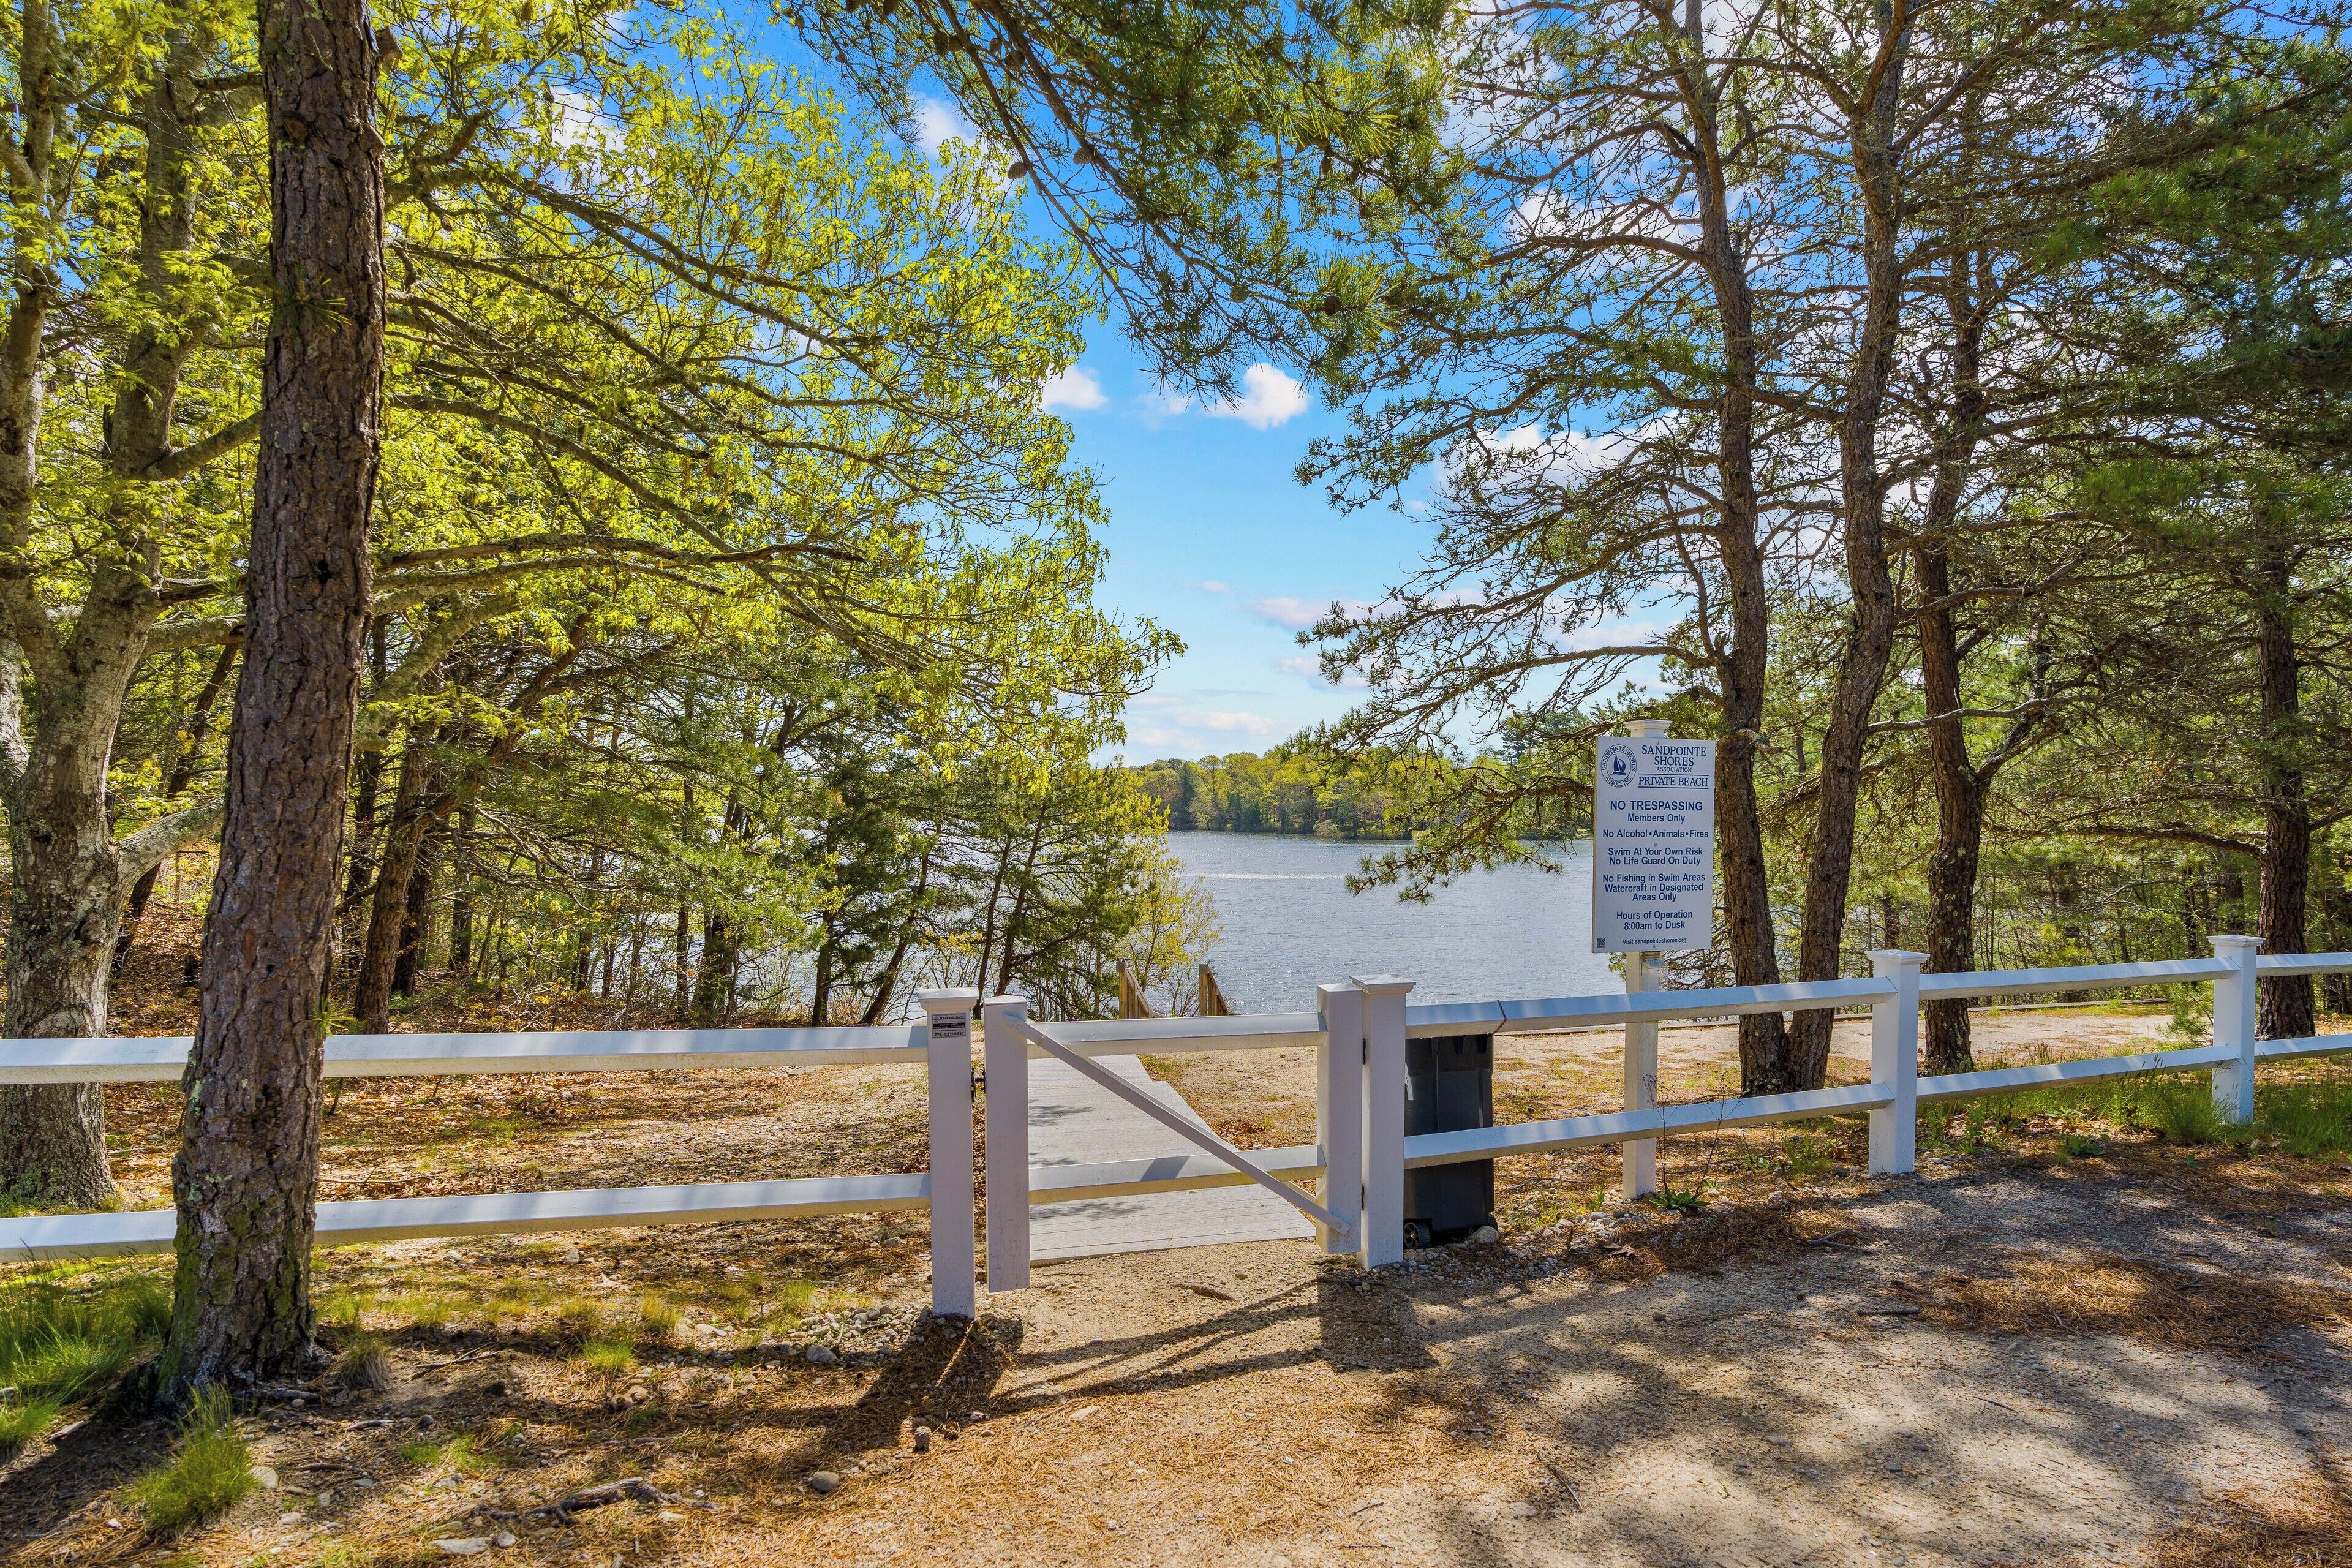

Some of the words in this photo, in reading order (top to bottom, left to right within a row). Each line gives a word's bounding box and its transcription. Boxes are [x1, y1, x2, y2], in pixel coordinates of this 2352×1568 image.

[1642, 745, 1706, 756] SANDPOINTE
[1602, 746, 1625, 770] SANDPOINTE
[1626, 749, 1635, 771] SHORES
[1654, 756, 1694, 766] SHORES
[1638, 776, 1676, 785] PRIVATE
[1678, 777, 1708, 786] BEACH
[1610, 800, 1626, 810] NO
[1630, 801, 1703, 811] TRESPASSING
[1627, 813, 1664, 822] Members
[1667, 813, 1685, 824] Only
[1608, 847, 1630, 856] Swim
[1633, 847, 1642, 856] At
[1645, 847, 1662, 856] Your
[1665, 847, 1683, 856] Own
[1624, 856, 1638, 865] Life
[1642, 856, 1665, 865] Guard
[1683, 856, 1701, 866] Duty
[1603, 874, 1614, 883] No
[1617, 874, 1646, 884] Fishing
[1605, 883, 1647, 892] Watercraft
[1659, 883, 1703, 893] Designated
[1632, 892, 1656, 901] Areas
[1659, 892, 1677, 902] Only
[1643, 910, 1652, 919] of
[1654, 910, 1692, 920] Operation
[1665, 921, 1685, 929] Dusk
